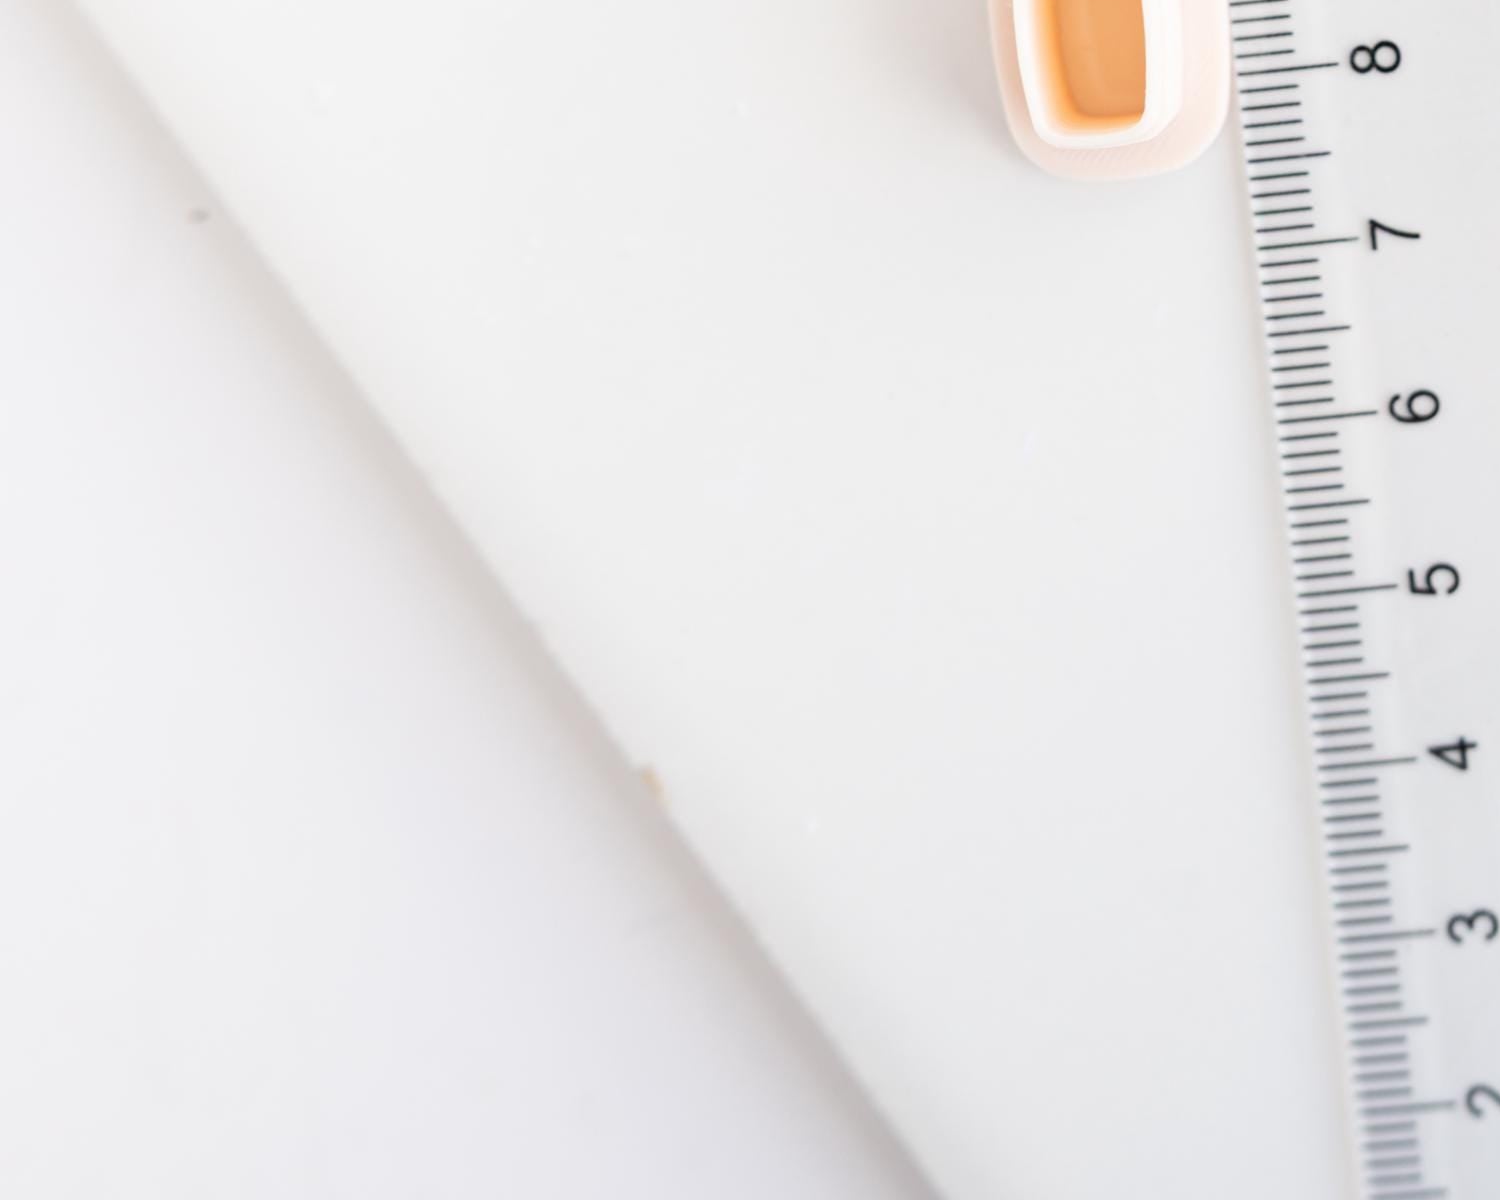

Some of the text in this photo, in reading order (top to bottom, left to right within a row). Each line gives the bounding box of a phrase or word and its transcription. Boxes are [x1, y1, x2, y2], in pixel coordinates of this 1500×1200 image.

[1347, 38, 1403, 76] 8
[1366, 217, 1423, 252] 7
[1386, 387, 1442, 426] 6
[1405, 561, 1462, 598] 5
[1426, 735, 1479, 772] 4
[1444, 907, 1500, 945] 3
